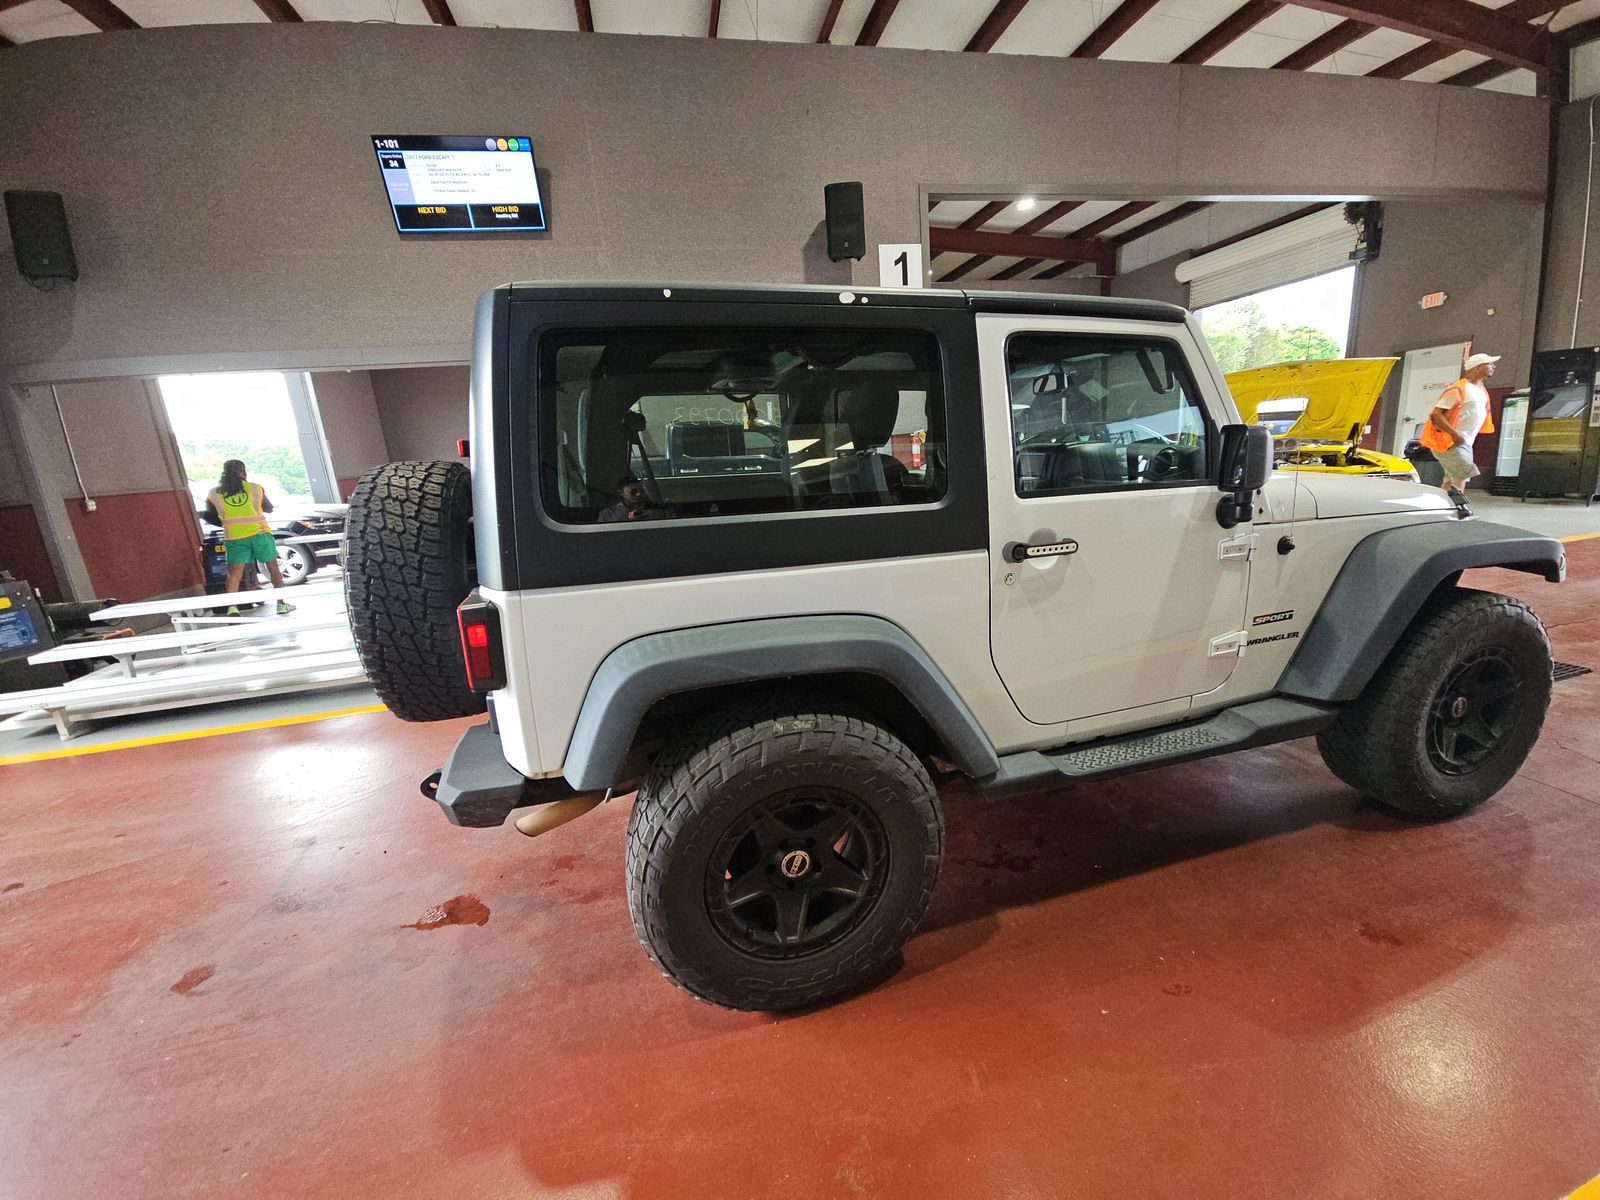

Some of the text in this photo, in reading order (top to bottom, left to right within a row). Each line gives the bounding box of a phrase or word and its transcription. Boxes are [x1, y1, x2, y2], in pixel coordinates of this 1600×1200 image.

[374, 139, 400, 149] 1-101
[894, 251, 909, 286] 1
[1424, 293, 1441, 308] EXIT
[1253, 611, 1294, 626] SPORT
[1247, 632, 1299, 646] WRANGLER
